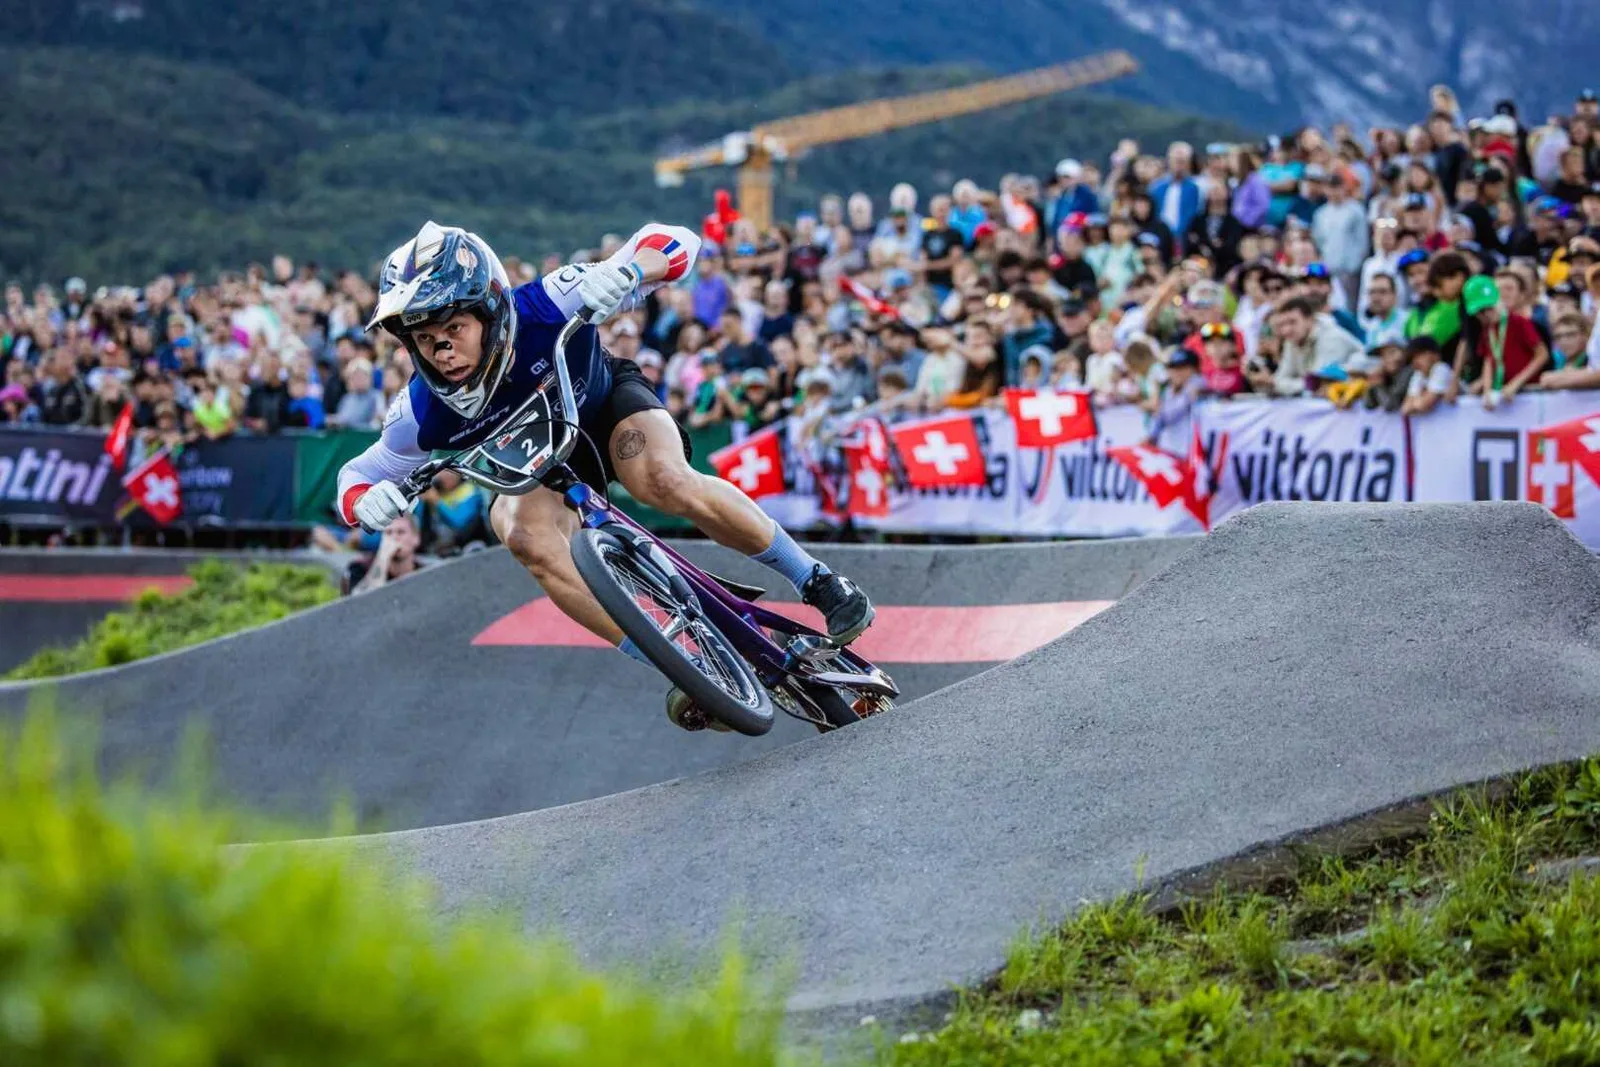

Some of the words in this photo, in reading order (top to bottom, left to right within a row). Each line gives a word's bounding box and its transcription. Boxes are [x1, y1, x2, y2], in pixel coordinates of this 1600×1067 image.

[521, 438, 538, 458] 2
[1060, 439, 1150, 502] vitto
[1233, 427, 1395, 502] vittoria
